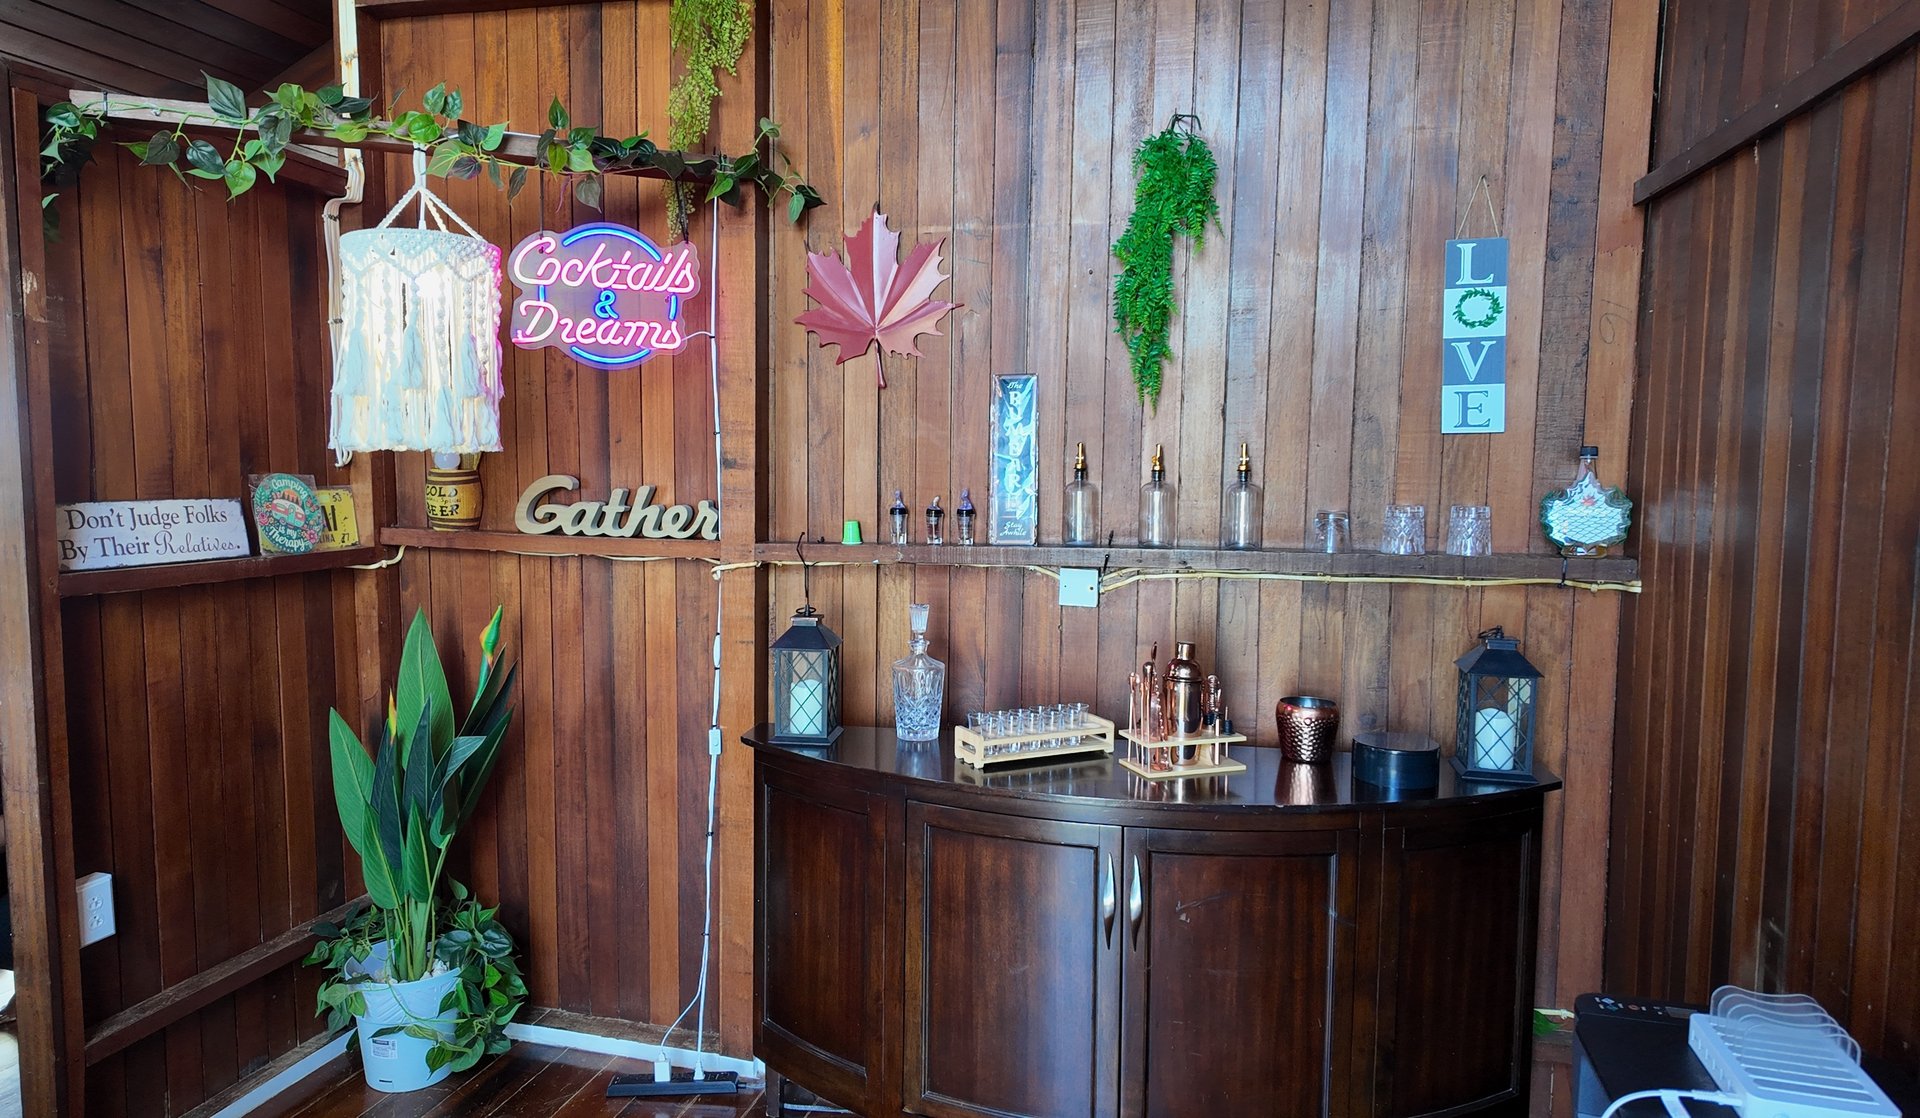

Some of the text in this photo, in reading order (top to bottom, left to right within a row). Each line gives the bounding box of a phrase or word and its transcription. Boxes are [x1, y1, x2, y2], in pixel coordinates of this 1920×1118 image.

[513, 236, 695, 294] Cocktails
[594, 289, 619, 320] &
[511, 299, 683, 349] Dreams
[1006, 381, 1024, 389] The
[271, 478, 308, 500] Camping
[64, 503, 228, 530] Don't Judge Folks
[514, 474, 720, 541] Gather
[268, 526, 305, 552] Therapy
[278, 524, 298, 540] is my
[1000, 528, 1027, 537] Awhile
[1003, 521, 1023, 532] Stay
[58, 530, 241, 563] By Their Relatives.
